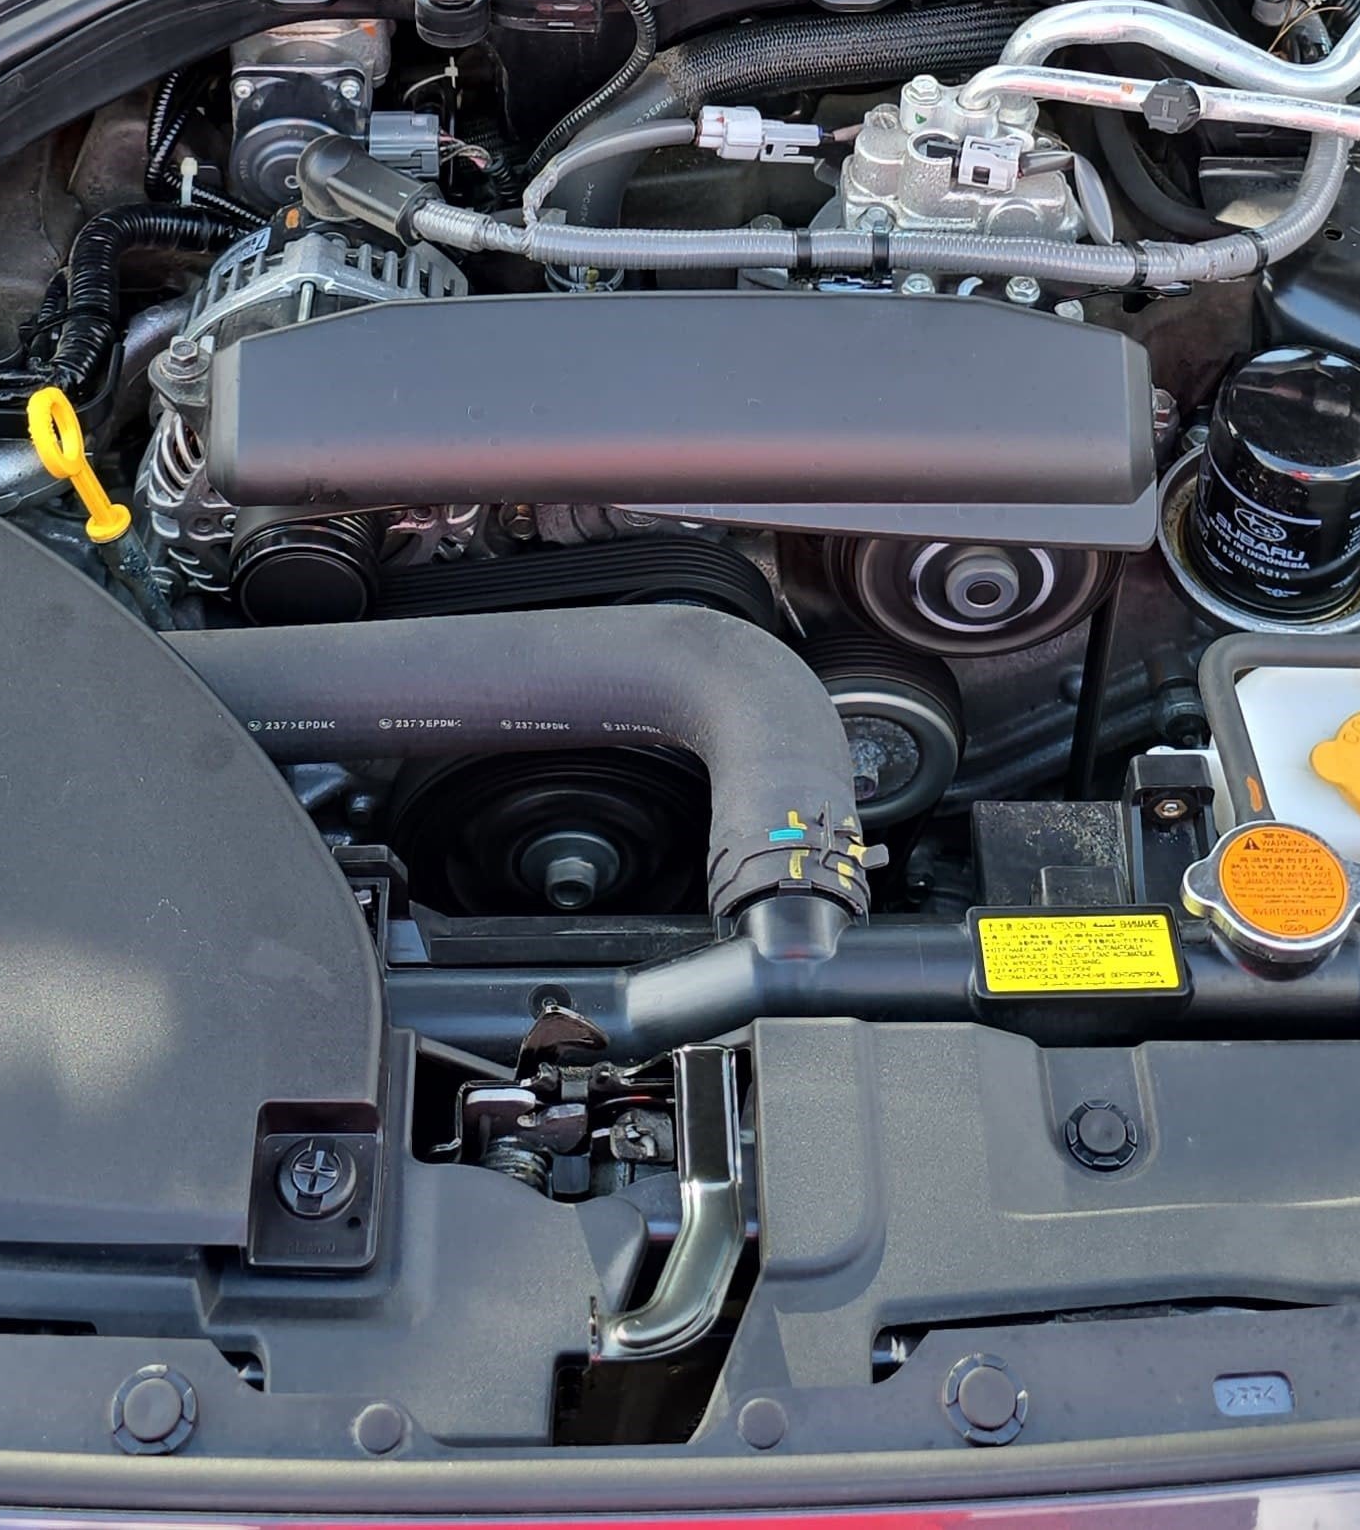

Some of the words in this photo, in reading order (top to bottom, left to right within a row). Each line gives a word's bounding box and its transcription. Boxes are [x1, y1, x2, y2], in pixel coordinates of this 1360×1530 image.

[1209, 516, 1232, 543] MADE
[1233, 540, 1245, 554] IN
[1246, 548, 1310, 570] INDONESIA
[1215, 511, 1306, 562] SUBARU
[265, 721, 287, 730] 237
[290, 720, 335, 730] >EPDM<
[395, 719, 417, 728] 237
